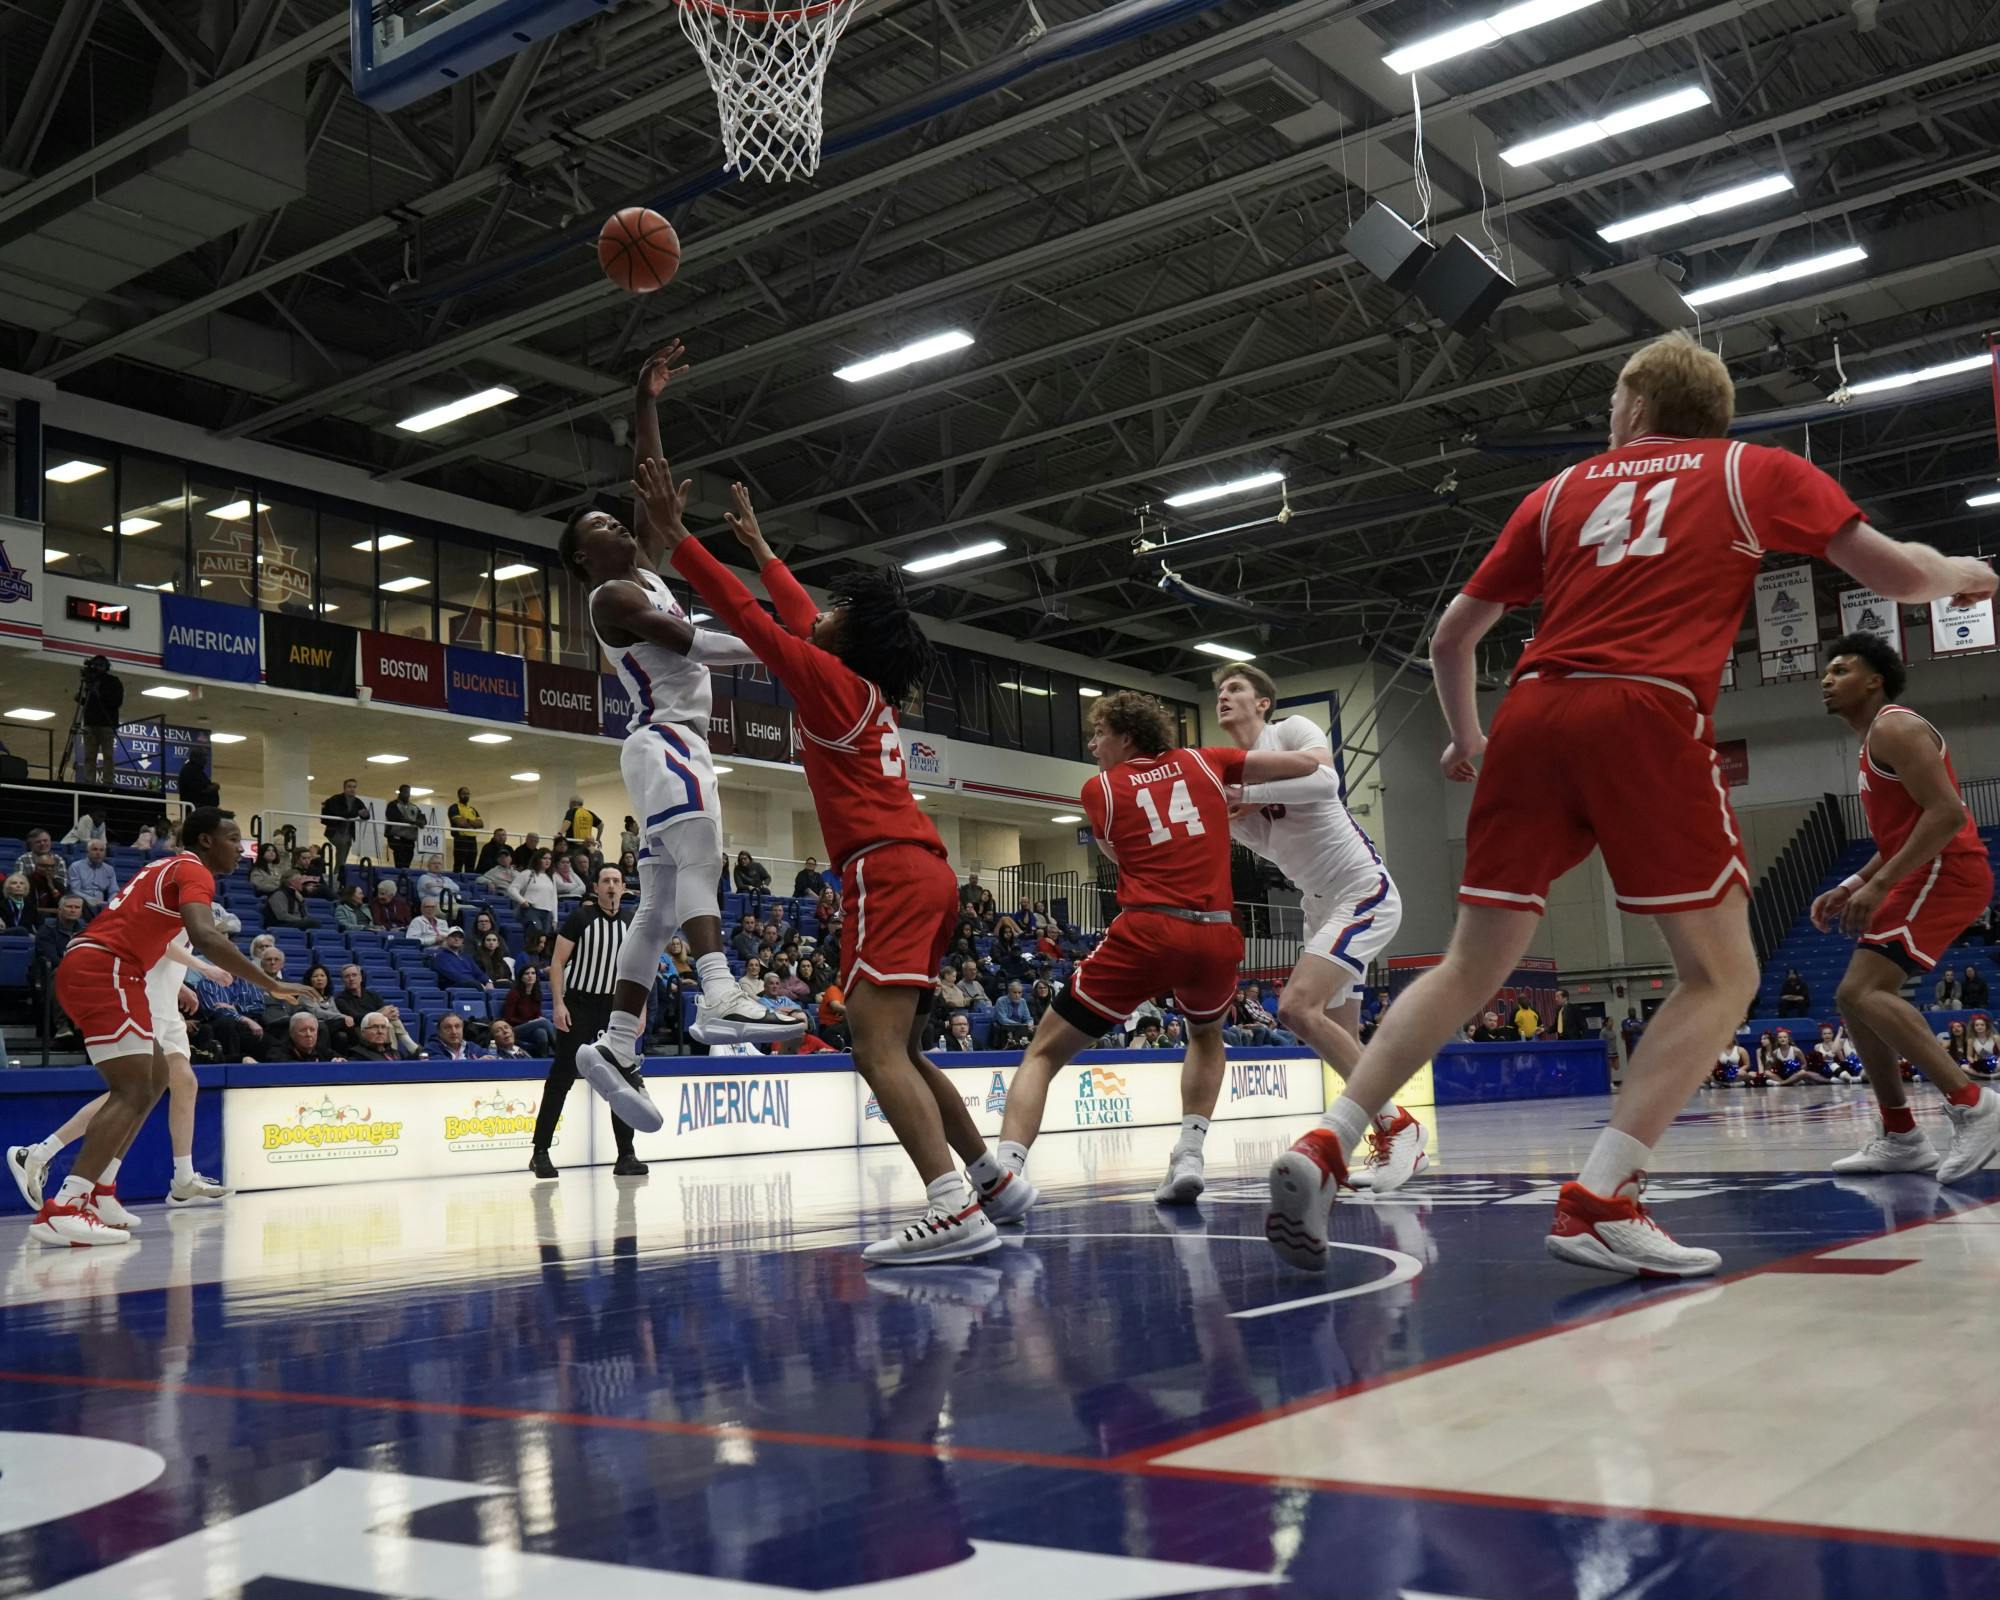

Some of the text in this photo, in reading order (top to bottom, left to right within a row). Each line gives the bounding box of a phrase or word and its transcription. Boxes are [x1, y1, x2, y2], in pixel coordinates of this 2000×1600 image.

[1585, 453, 1704, 479] LANDRUM
[1579, 477, 1677, 567] 41
[1758, 577, 1808, 591] VOLLEYBALL
[1763, 570, 1800, 582] WOMEN'S
[168, 625, 256, 655] AMERICAN
[289, 645, 333, 668] ARMY
[380, 658, 429, 682] BOSTON
[453, 670, 519, 698] BUCKNELL
[540, 688, 592, 711] COLGATE
[604, 697, 631, 717] HOLY
[746, 721, 781, 741] LEHIGH
[132, 740, 159, 752] EXIT
[174, 745, 190, 756] 107
[909, 756, 939, 767] PATRIOT
[909, 761, 939, 773] LEAGUE
[1128, 761, 1183, 786] NOBILI
[1136, 779, 1206, 846] 14
[423, 835, 439, 847] 104
[1231, 1064, 1288, 1103] AMERICAN
[677, 1080, 790, 1136] AMERICAN
[1075, 1097, 1132, 1113] PATRIOT
[1077, 1109, 1134, 1125] LEAGUE
[263, 1122, 402, 1149] Booeymonger
